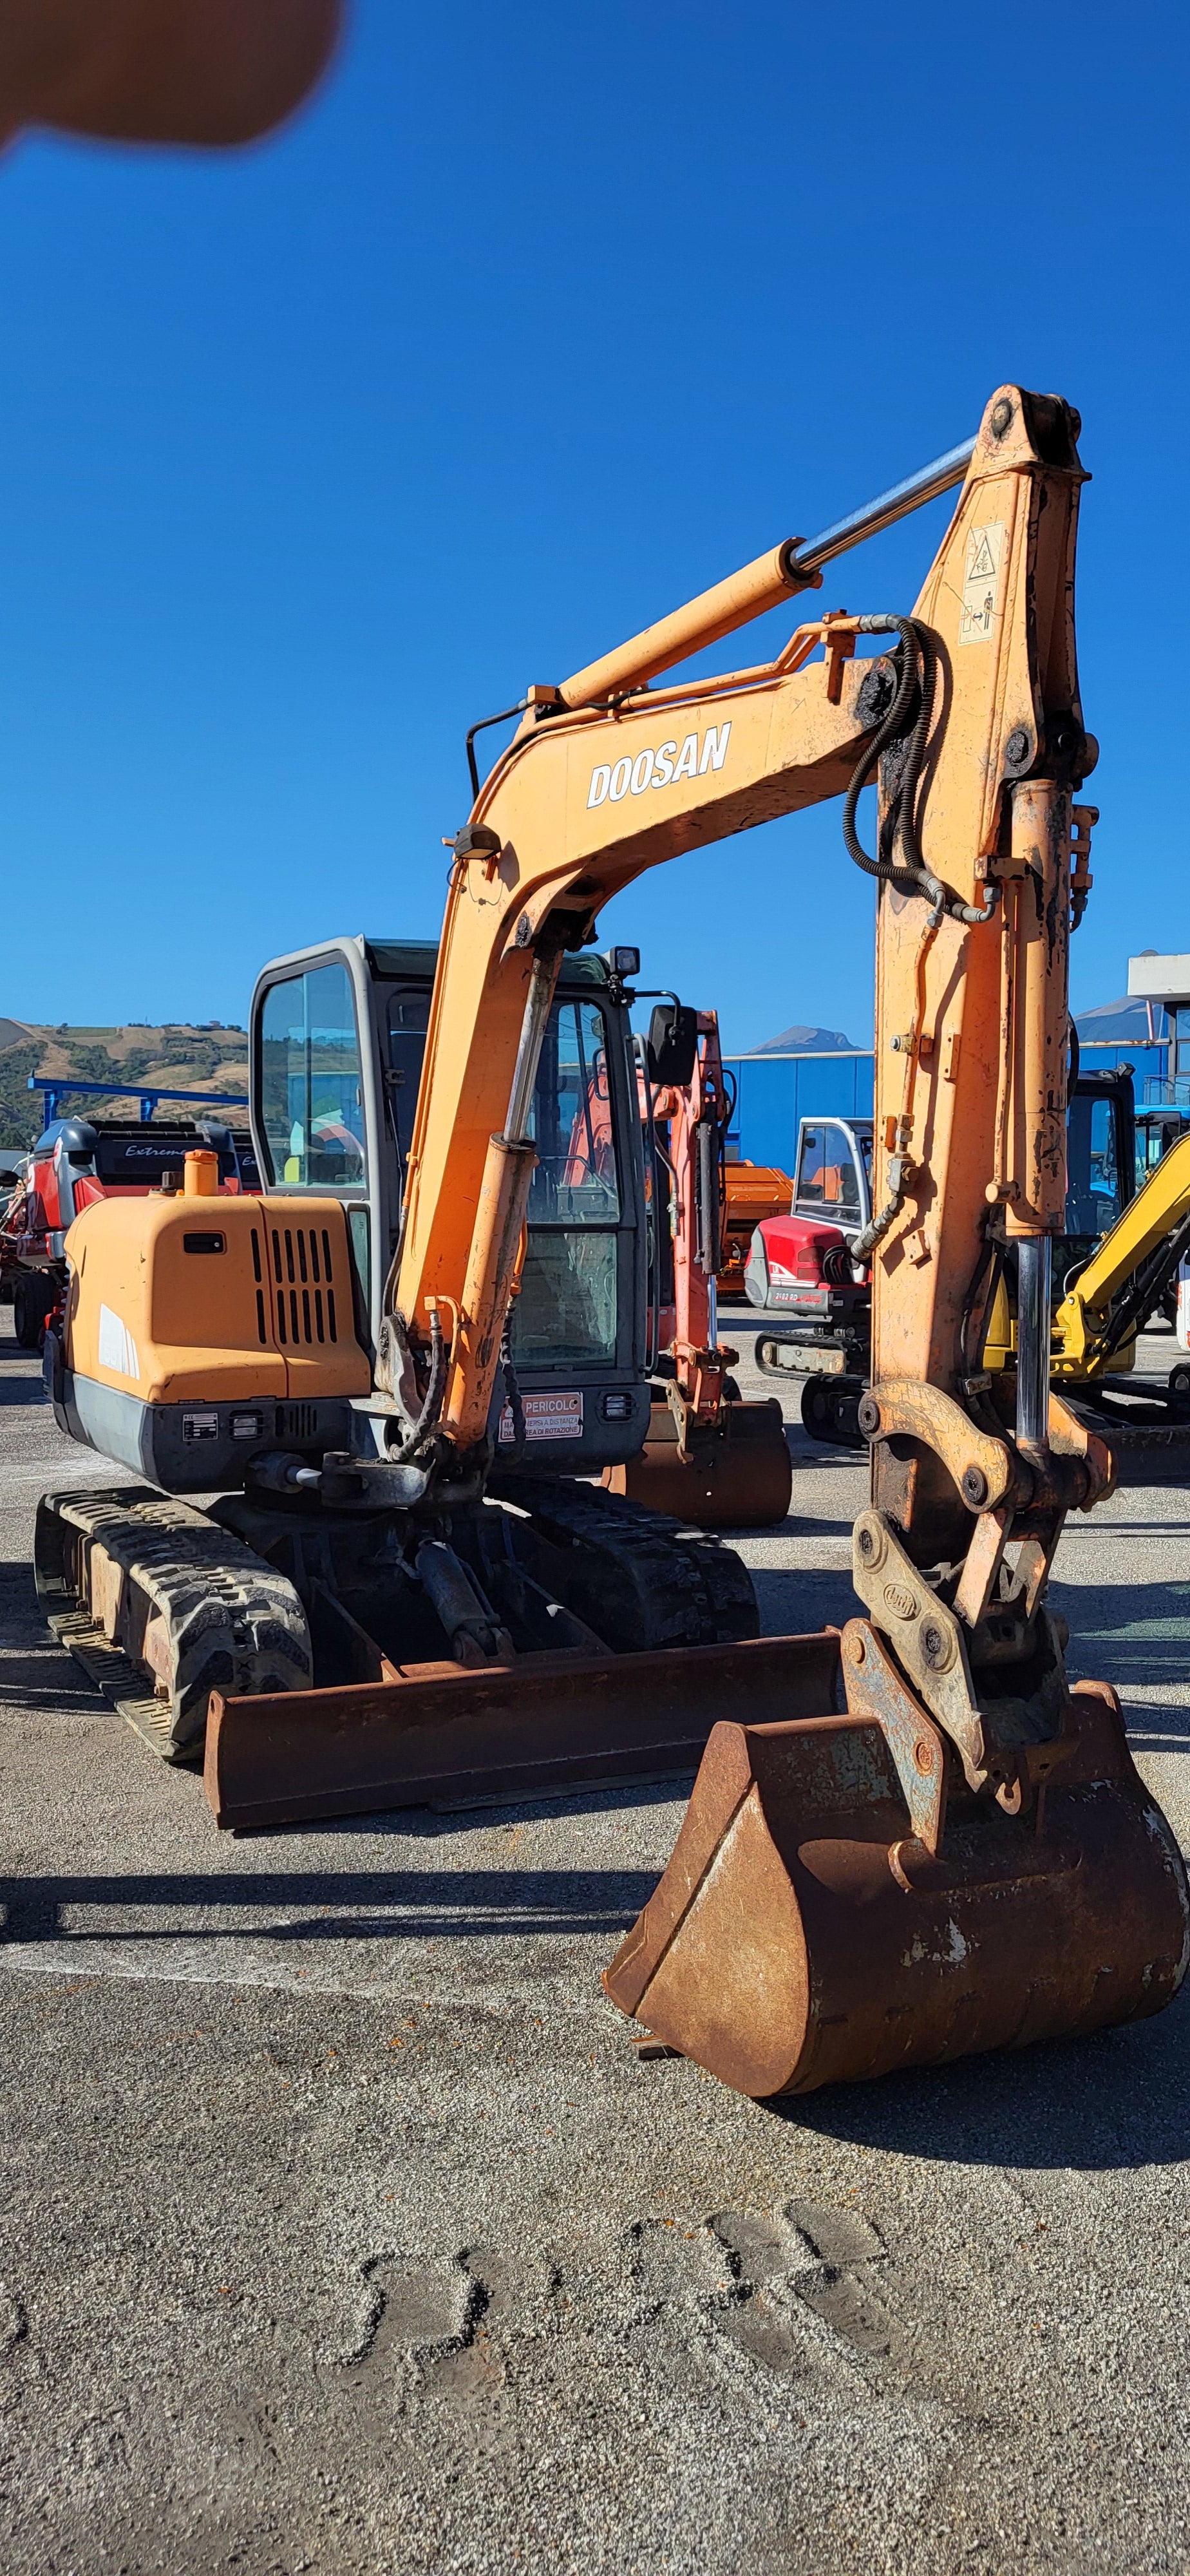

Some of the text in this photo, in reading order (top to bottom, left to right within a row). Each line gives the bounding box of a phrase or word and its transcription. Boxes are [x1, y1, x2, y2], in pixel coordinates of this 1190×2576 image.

[587, 721, 732, 810] DOOSAN
[125, 1145, 185, 1156] Extreme
[525, 1399, 577, 1413] PERICOLO
[545, 1425, 578, 1434] ROTAZIONE
